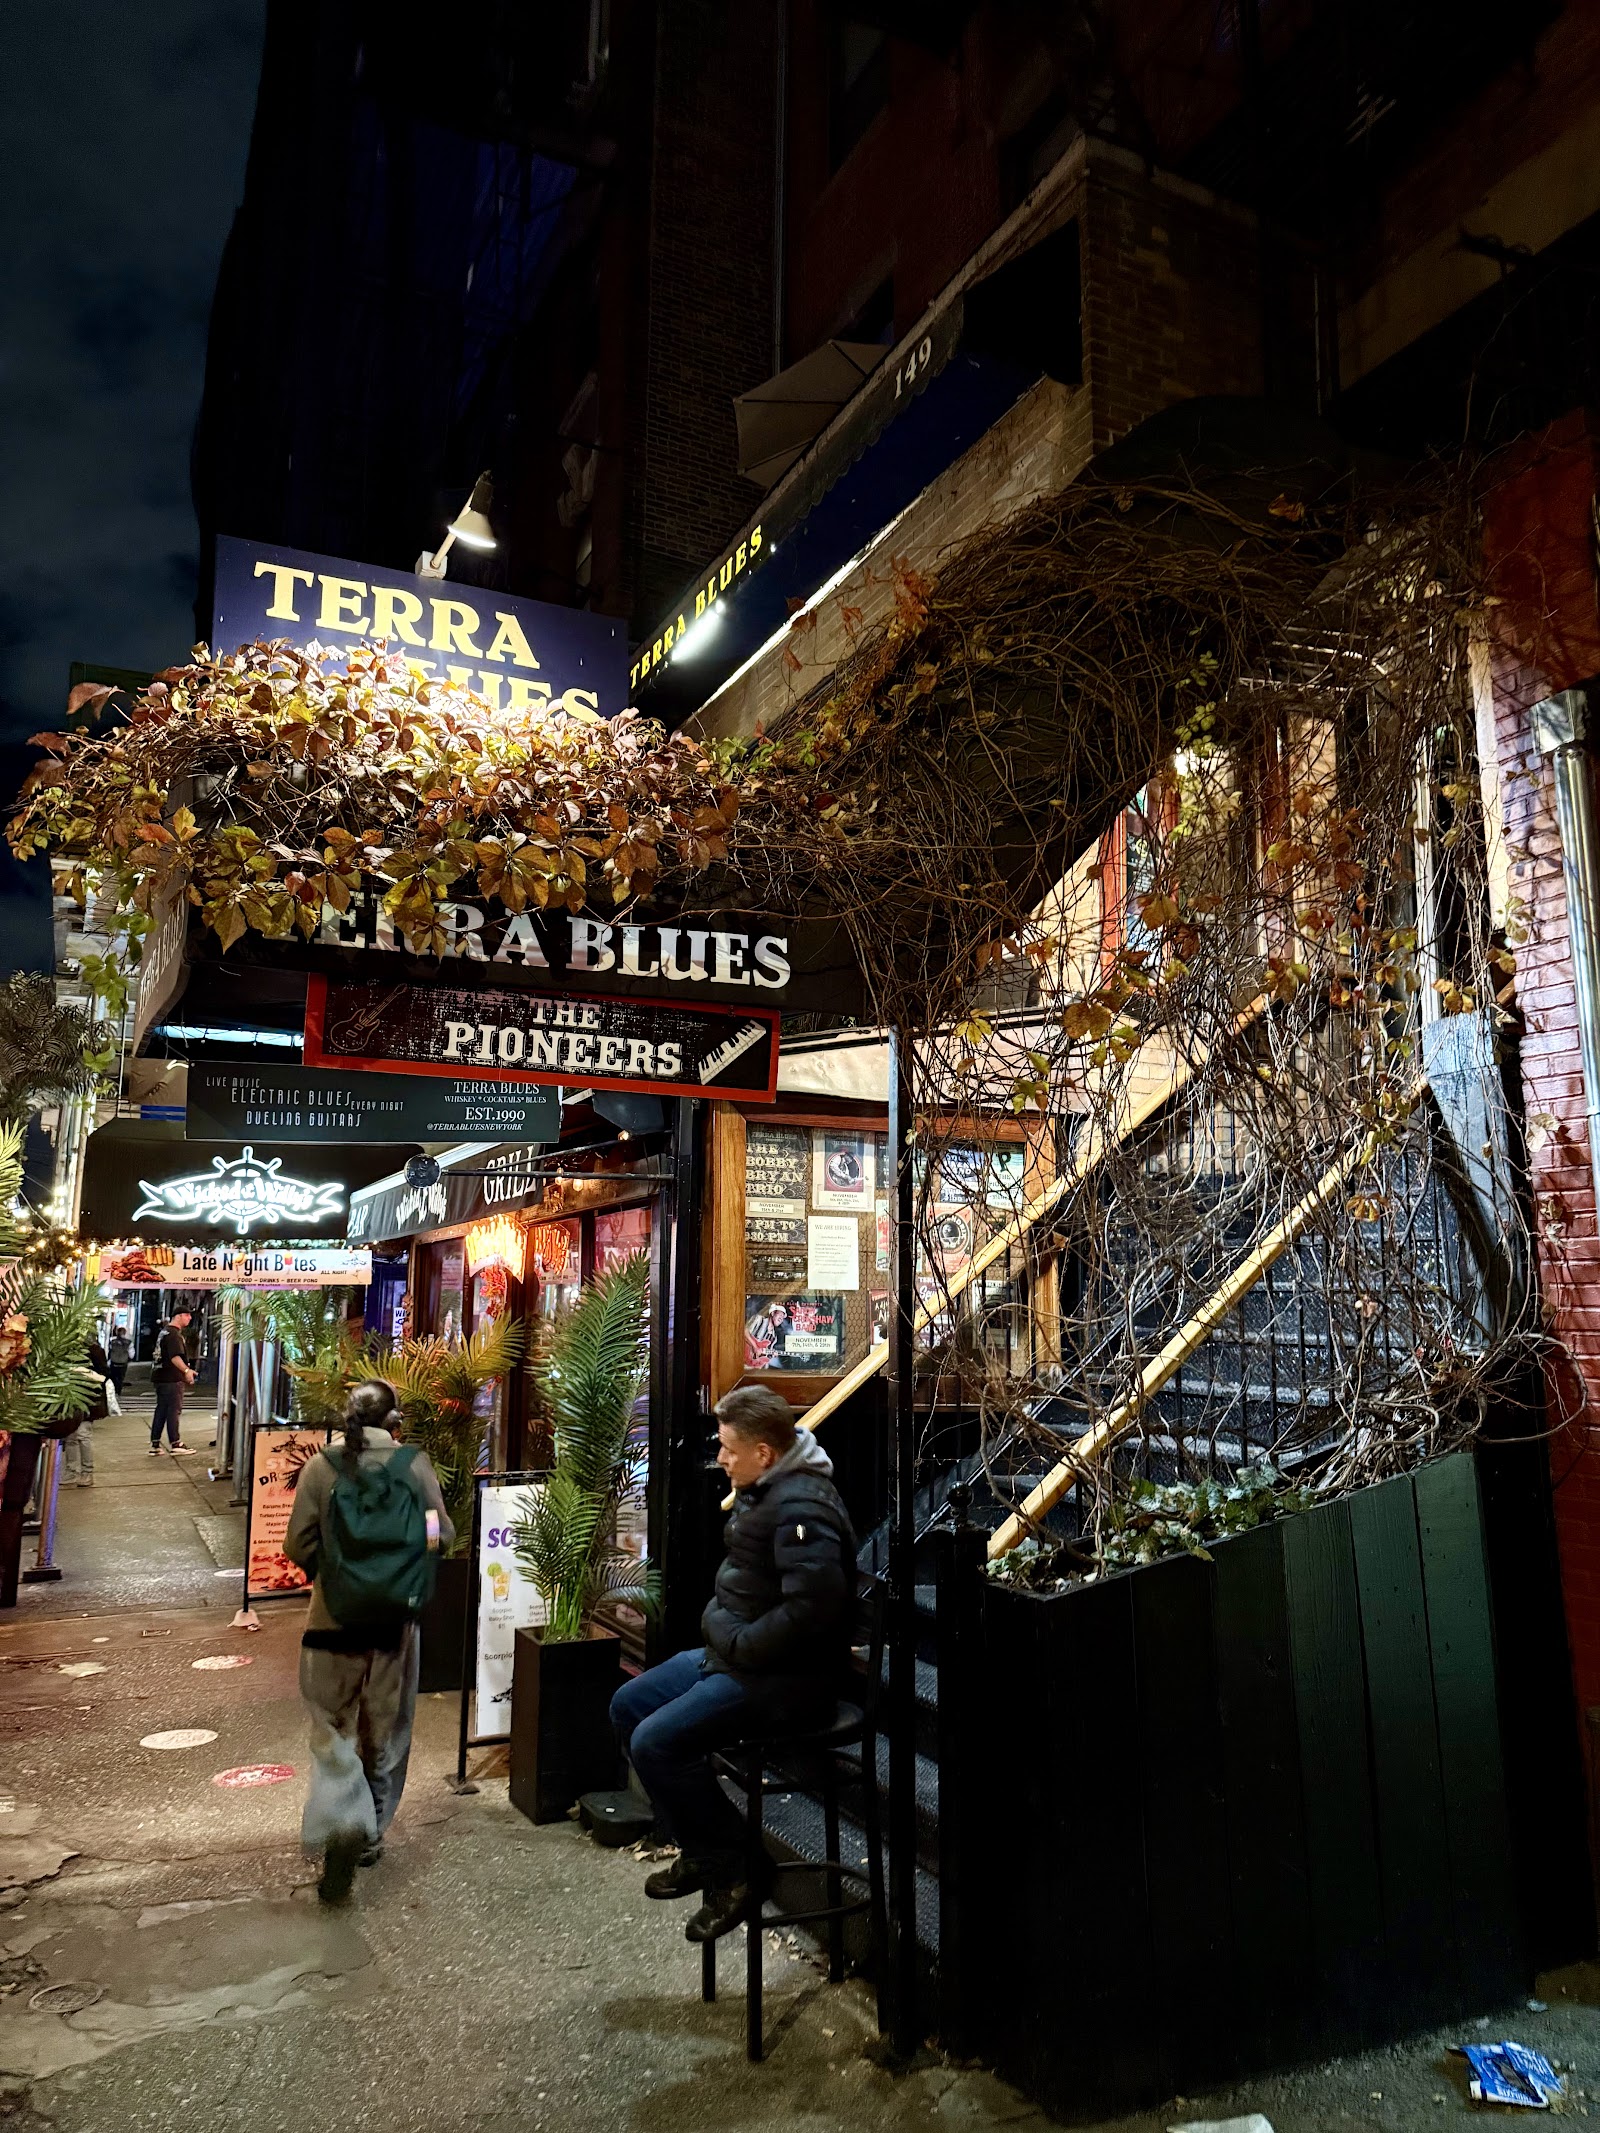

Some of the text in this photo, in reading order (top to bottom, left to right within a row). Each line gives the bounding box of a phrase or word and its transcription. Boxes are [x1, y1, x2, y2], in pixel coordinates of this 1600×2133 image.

[895, 336, 931, 400] 149
[254, 561, 540, 669] TERRA
[630, 524, 762, 690] TERRA BLUES
[262, 890, 791, 990] ERA BLUES
[531, 1000, 601, 1029] THE
[443, 1020, 683, 1077] PIONEERS
[206, 1076, 260, 1089] LIVE MUSIC
[453, 1081, 540, 1095] TERRA BLUES
[231, 1088, 351, 1107] ELECTRIC BLUES
[351, 1101, 404, 1111] EVERY NIGHT
[444, 1095, 477, 1104] WHISKEY
[525, 1096, 547, 1104] BLUES
[246, 1110, 361, 1127] DUELING GUITARS
[465, 1107, 526, 1122] EST.1990
[426, 1122, 523, 1132] @TERRABLUESNEWYORK
[746, 1156, 798, 1169] BOBBY
[483, 1145, 537, 1206] GRILL
[746, 1169, 804, 1184] BRYAN
[780, 1220, 796, 1231] TO
[183, 1252, 217, 1271] Late
[222, 1251, 269, 1277] Nght
[274, 1252, 317, 1273] Btes
